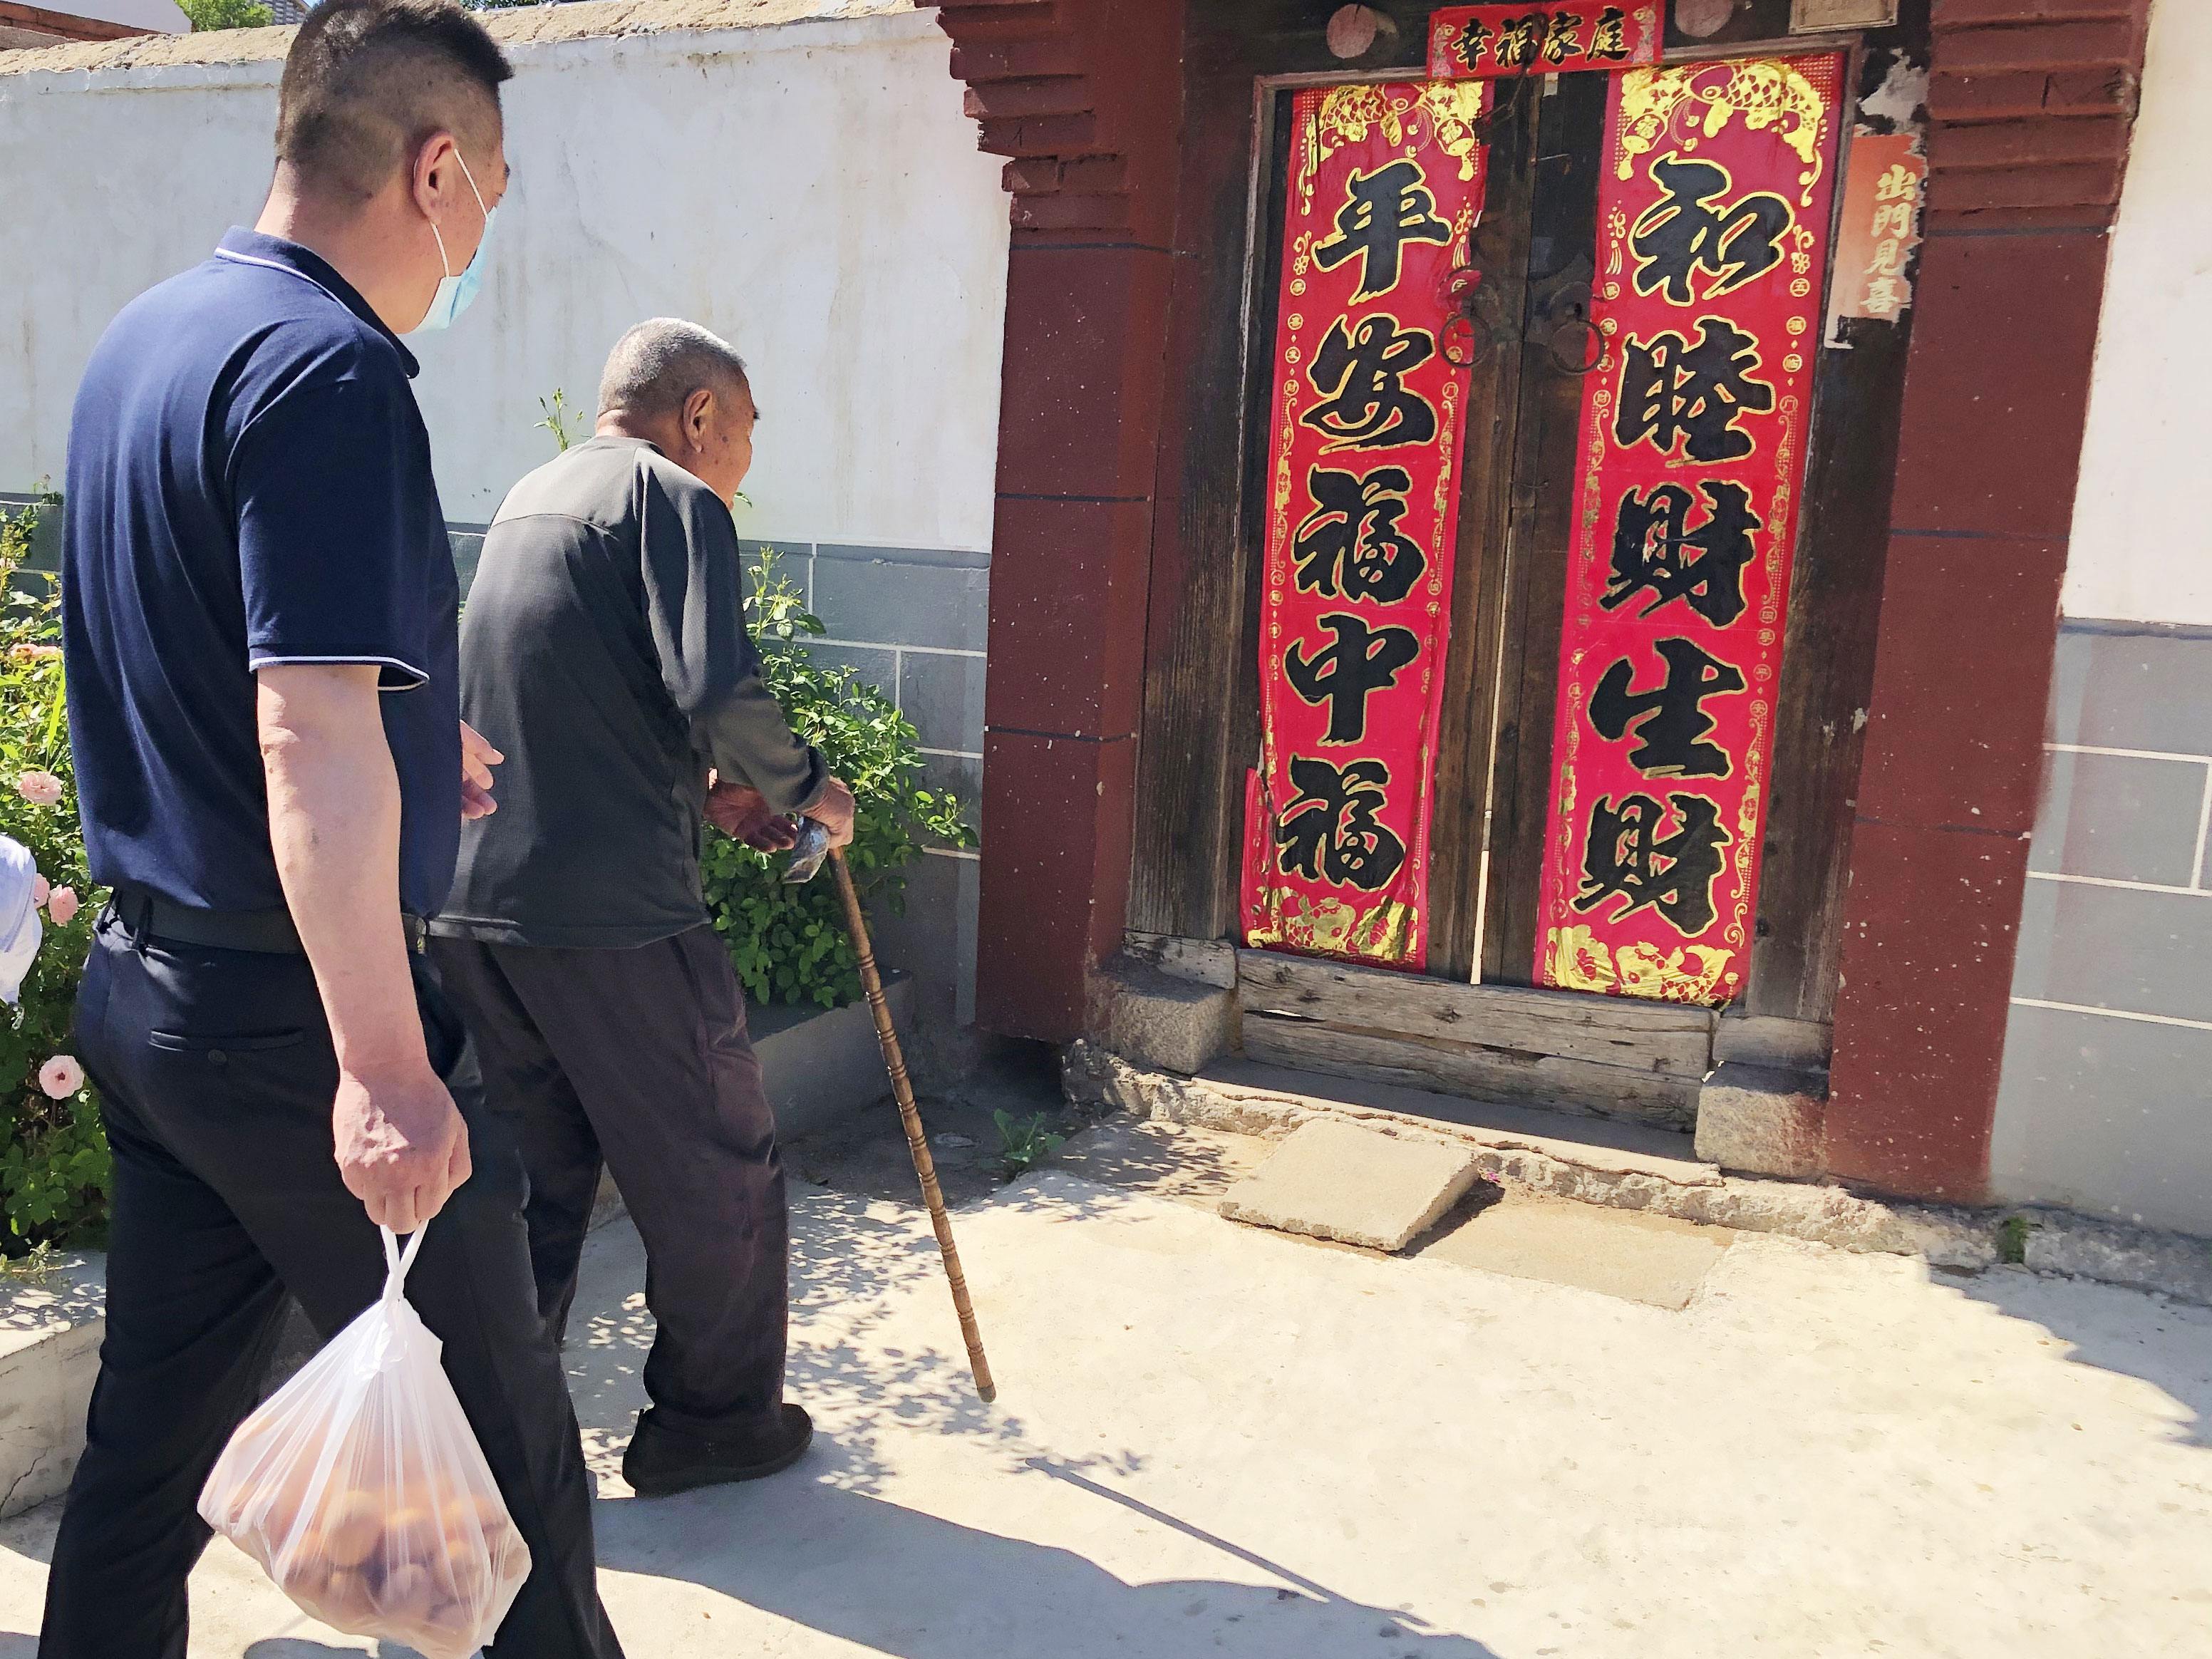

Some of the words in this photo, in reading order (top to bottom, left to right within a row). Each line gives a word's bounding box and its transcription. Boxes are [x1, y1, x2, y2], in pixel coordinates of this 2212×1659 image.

[1451, 6, 1632, 73] 幸福家庭
[1860, 164, 1917, 314] 出門見喜
[1276, 157, 1454, 892] 平安福中福
